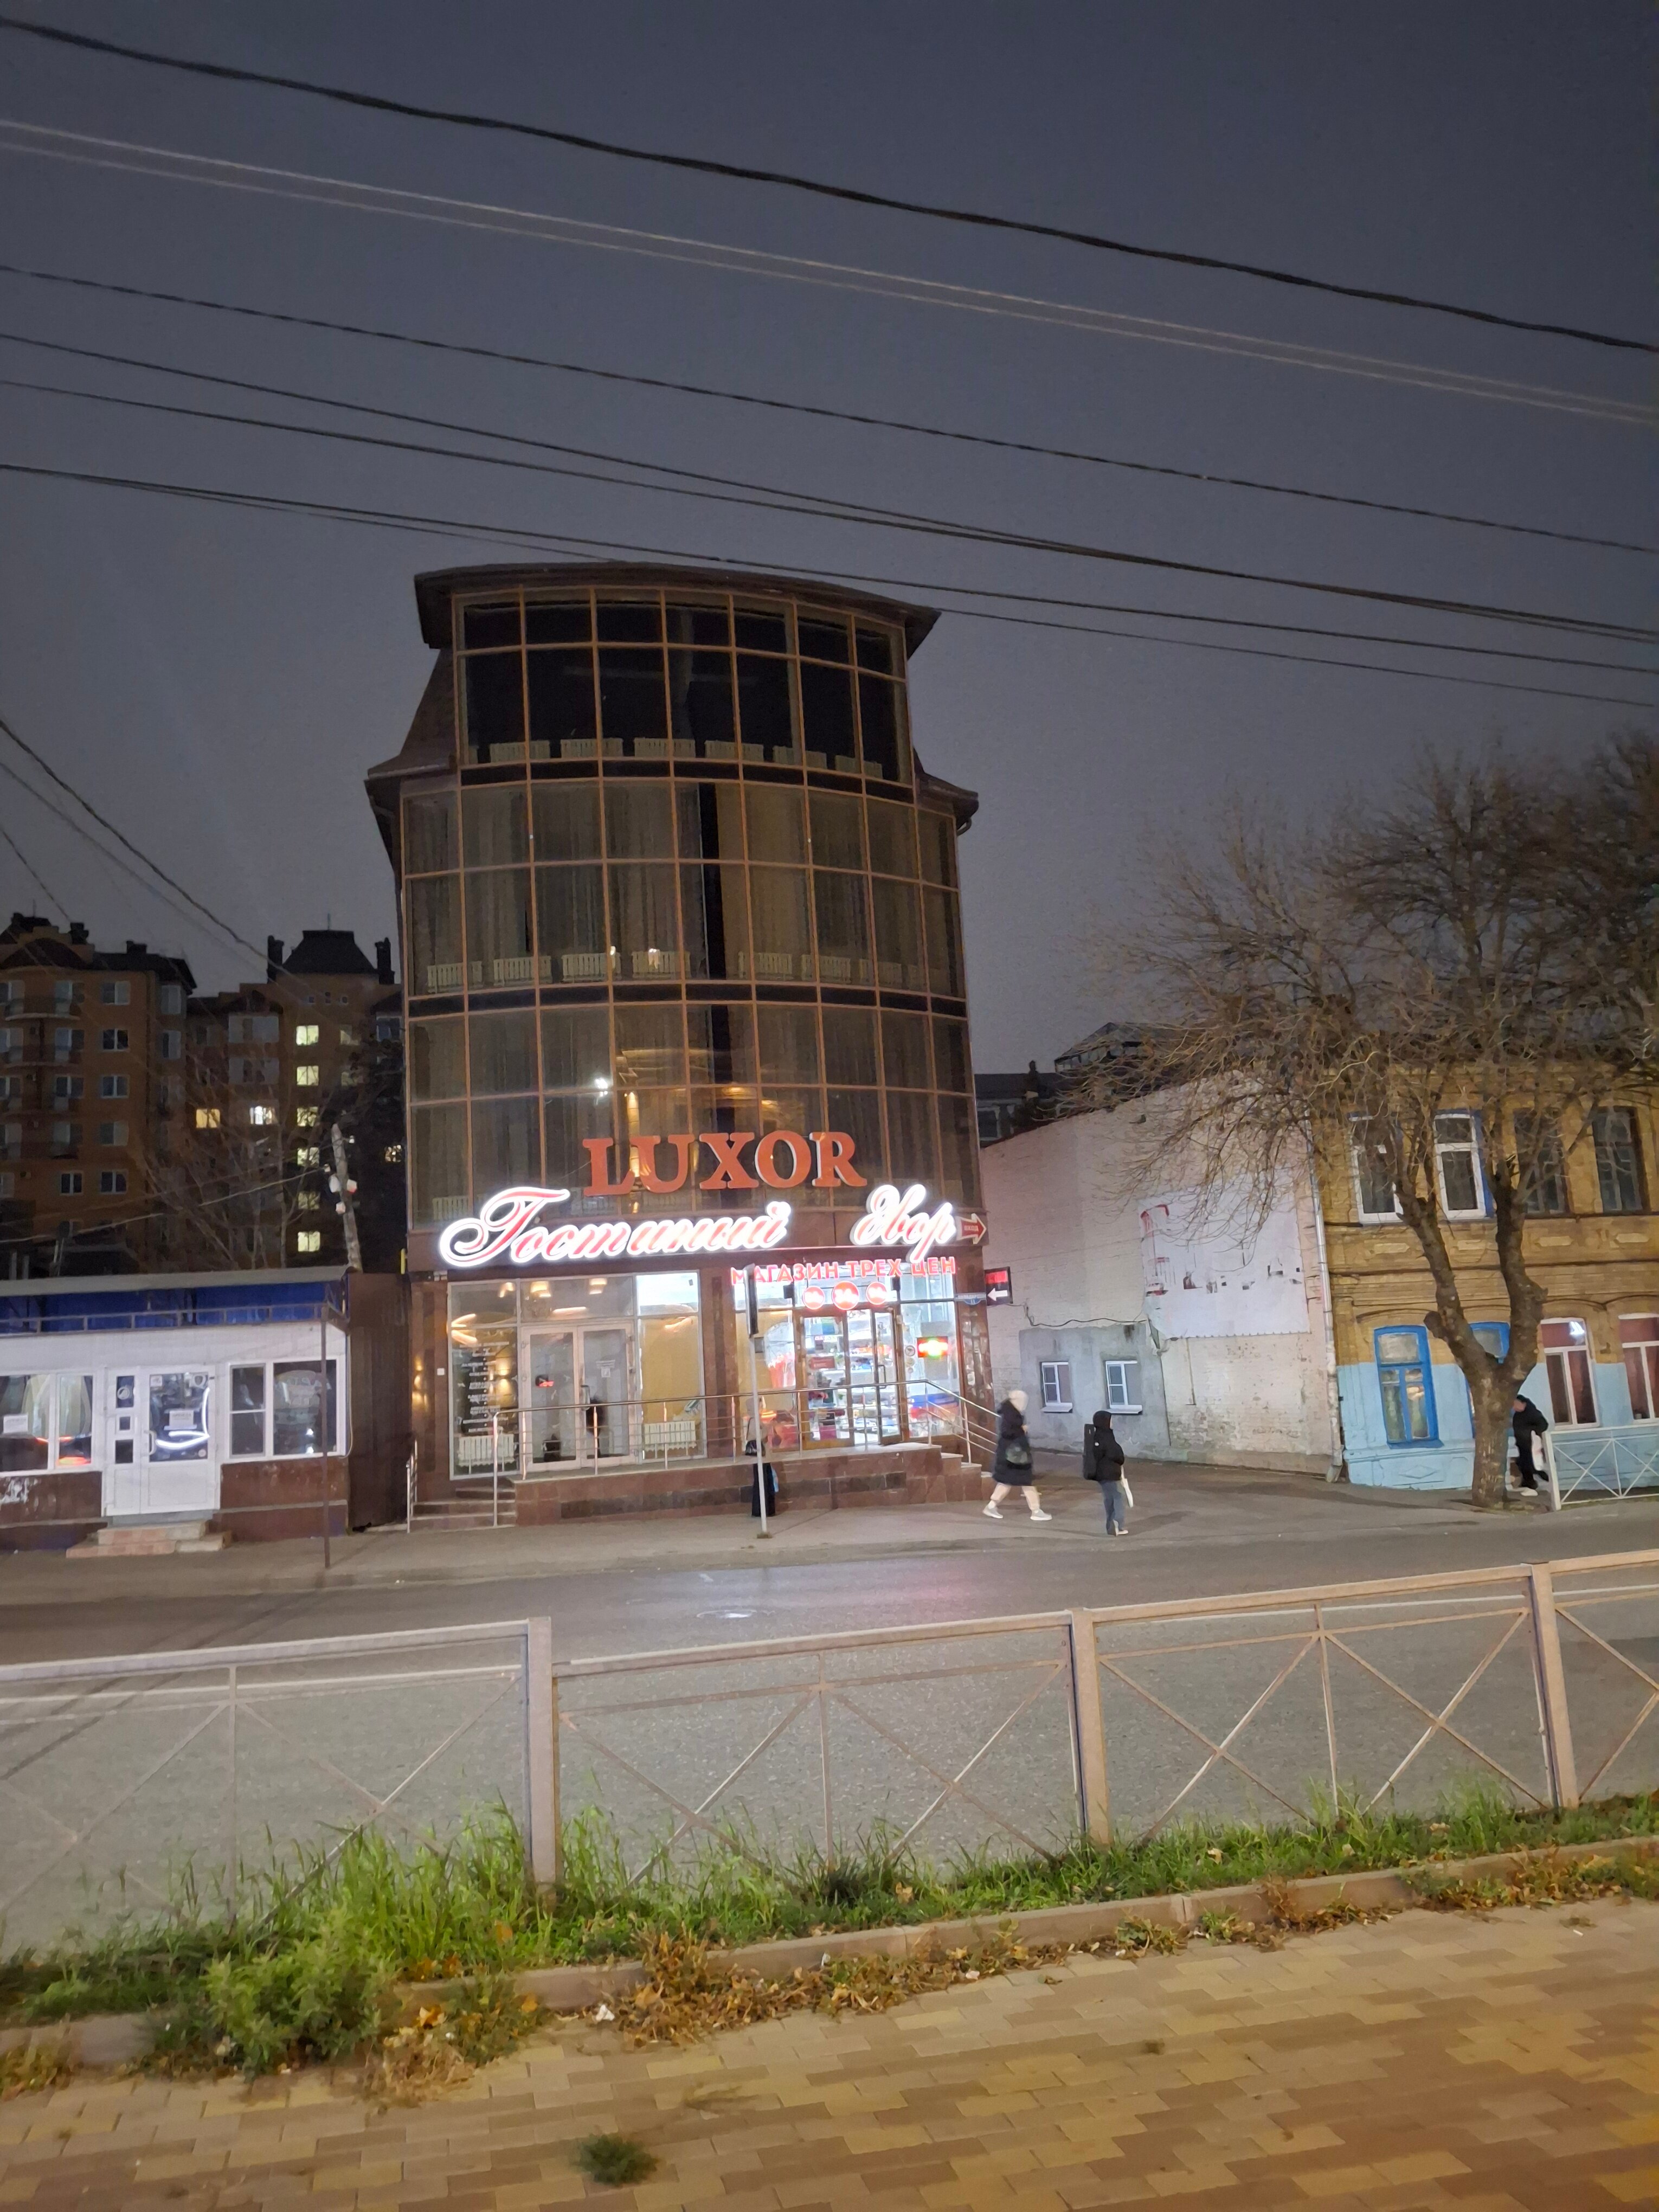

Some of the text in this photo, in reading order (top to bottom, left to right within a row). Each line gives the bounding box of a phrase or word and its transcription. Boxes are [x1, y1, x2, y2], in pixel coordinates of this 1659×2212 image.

[582, 1130, 867, 1196] LUXOR
[440, 1184, 956, 1266] Гостиный Двор
[730, 1256, 956, 1286] МАГАЗИН ТРЕХ ЦЕН
